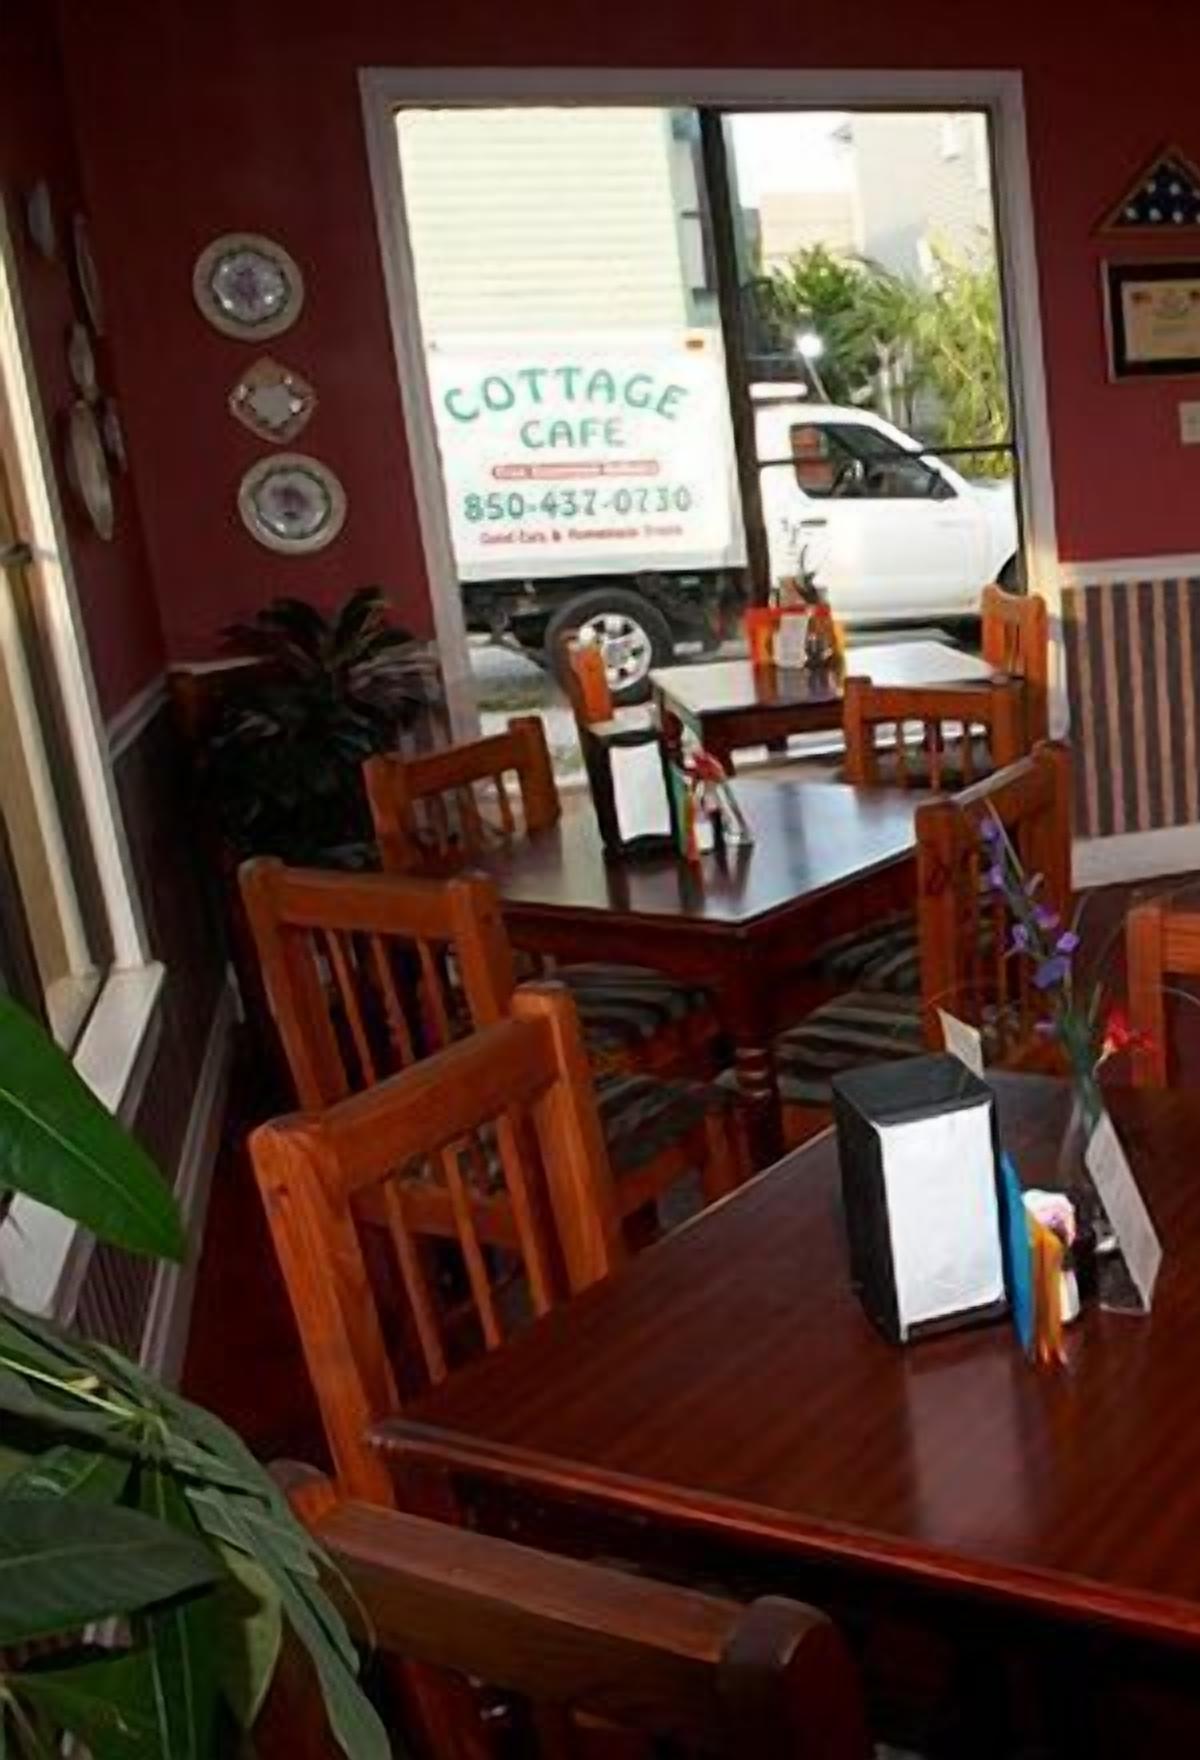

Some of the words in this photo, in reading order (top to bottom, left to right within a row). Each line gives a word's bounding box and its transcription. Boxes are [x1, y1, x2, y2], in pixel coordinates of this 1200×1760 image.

[445, 366, 688, 421] COTTAGE
[520, 419, 626, 449] CAFE
[464, 487, 692, 522] 850-437-0730
